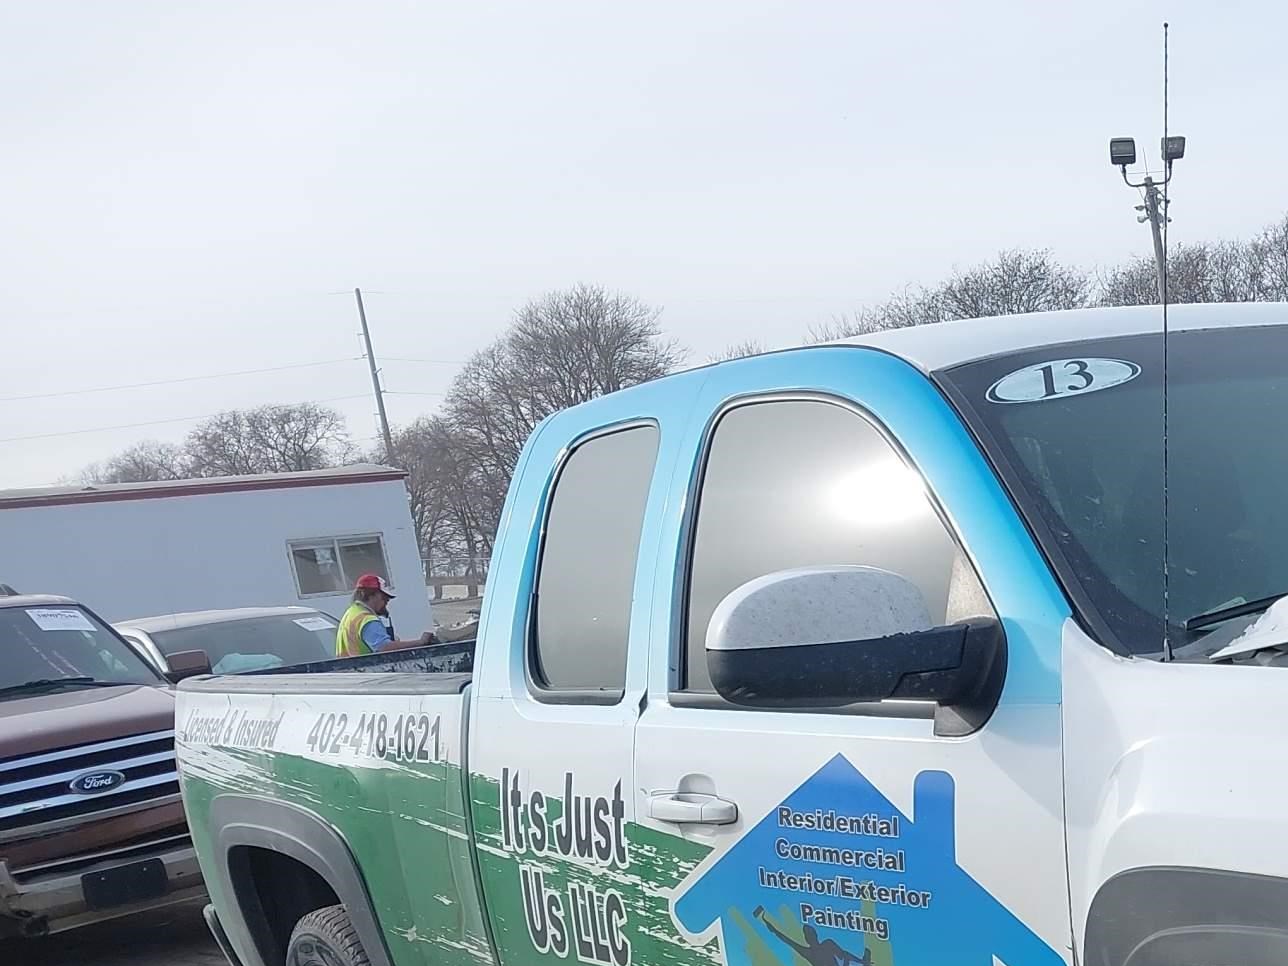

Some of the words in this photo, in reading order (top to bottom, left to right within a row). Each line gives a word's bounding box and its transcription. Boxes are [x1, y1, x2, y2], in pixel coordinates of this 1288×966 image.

[1034, 360, 1094, 399] 13
[183, 709, 225, 745] Licensed
[224, 709, 239, 744] &
[233, 710, 285, 748] Insured
[306, 711, 442, 762] 402-418-1621
[83, 774, 112, 789] Ford
[502, 767, 547, 855] Its
[555, 772, 628, 867] Just
[778, 806, 899, 838] Residential
[775, 838, 905, 872] Commercial
[759, 867, 931, 908] Interior/Exterior
[521, 868, 568, 955] Us
[800, 903, 889, 940] Painting
